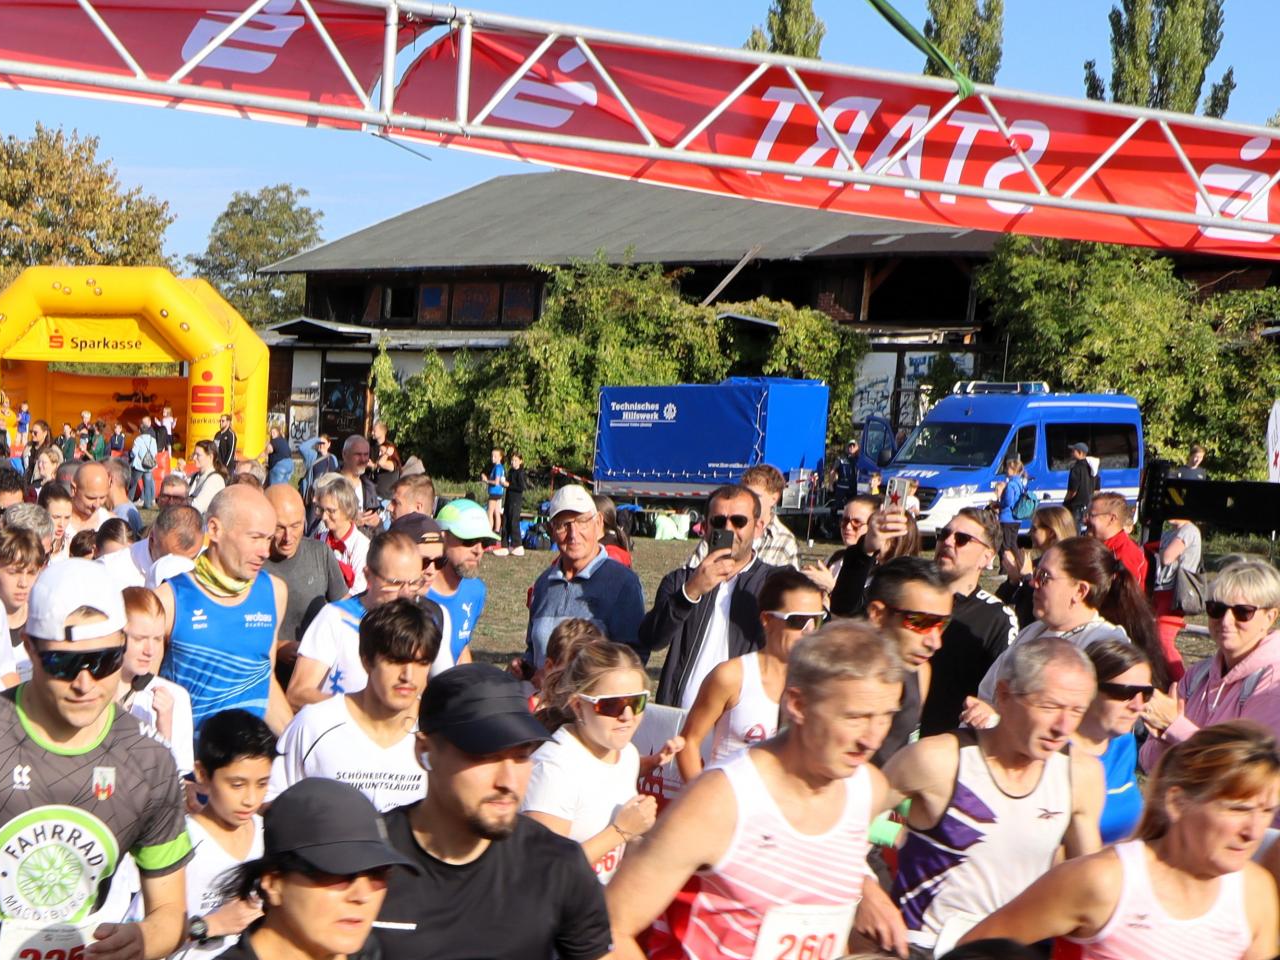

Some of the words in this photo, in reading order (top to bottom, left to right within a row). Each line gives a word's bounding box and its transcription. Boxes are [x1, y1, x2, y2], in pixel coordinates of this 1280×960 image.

[70, 336, 143, 351] Sparkasse
[610, 401, 660, 411] Technisches
[622, 410, 659, 421] Hilfswerk
[4, 823, 106, 868] FAHRRAD
